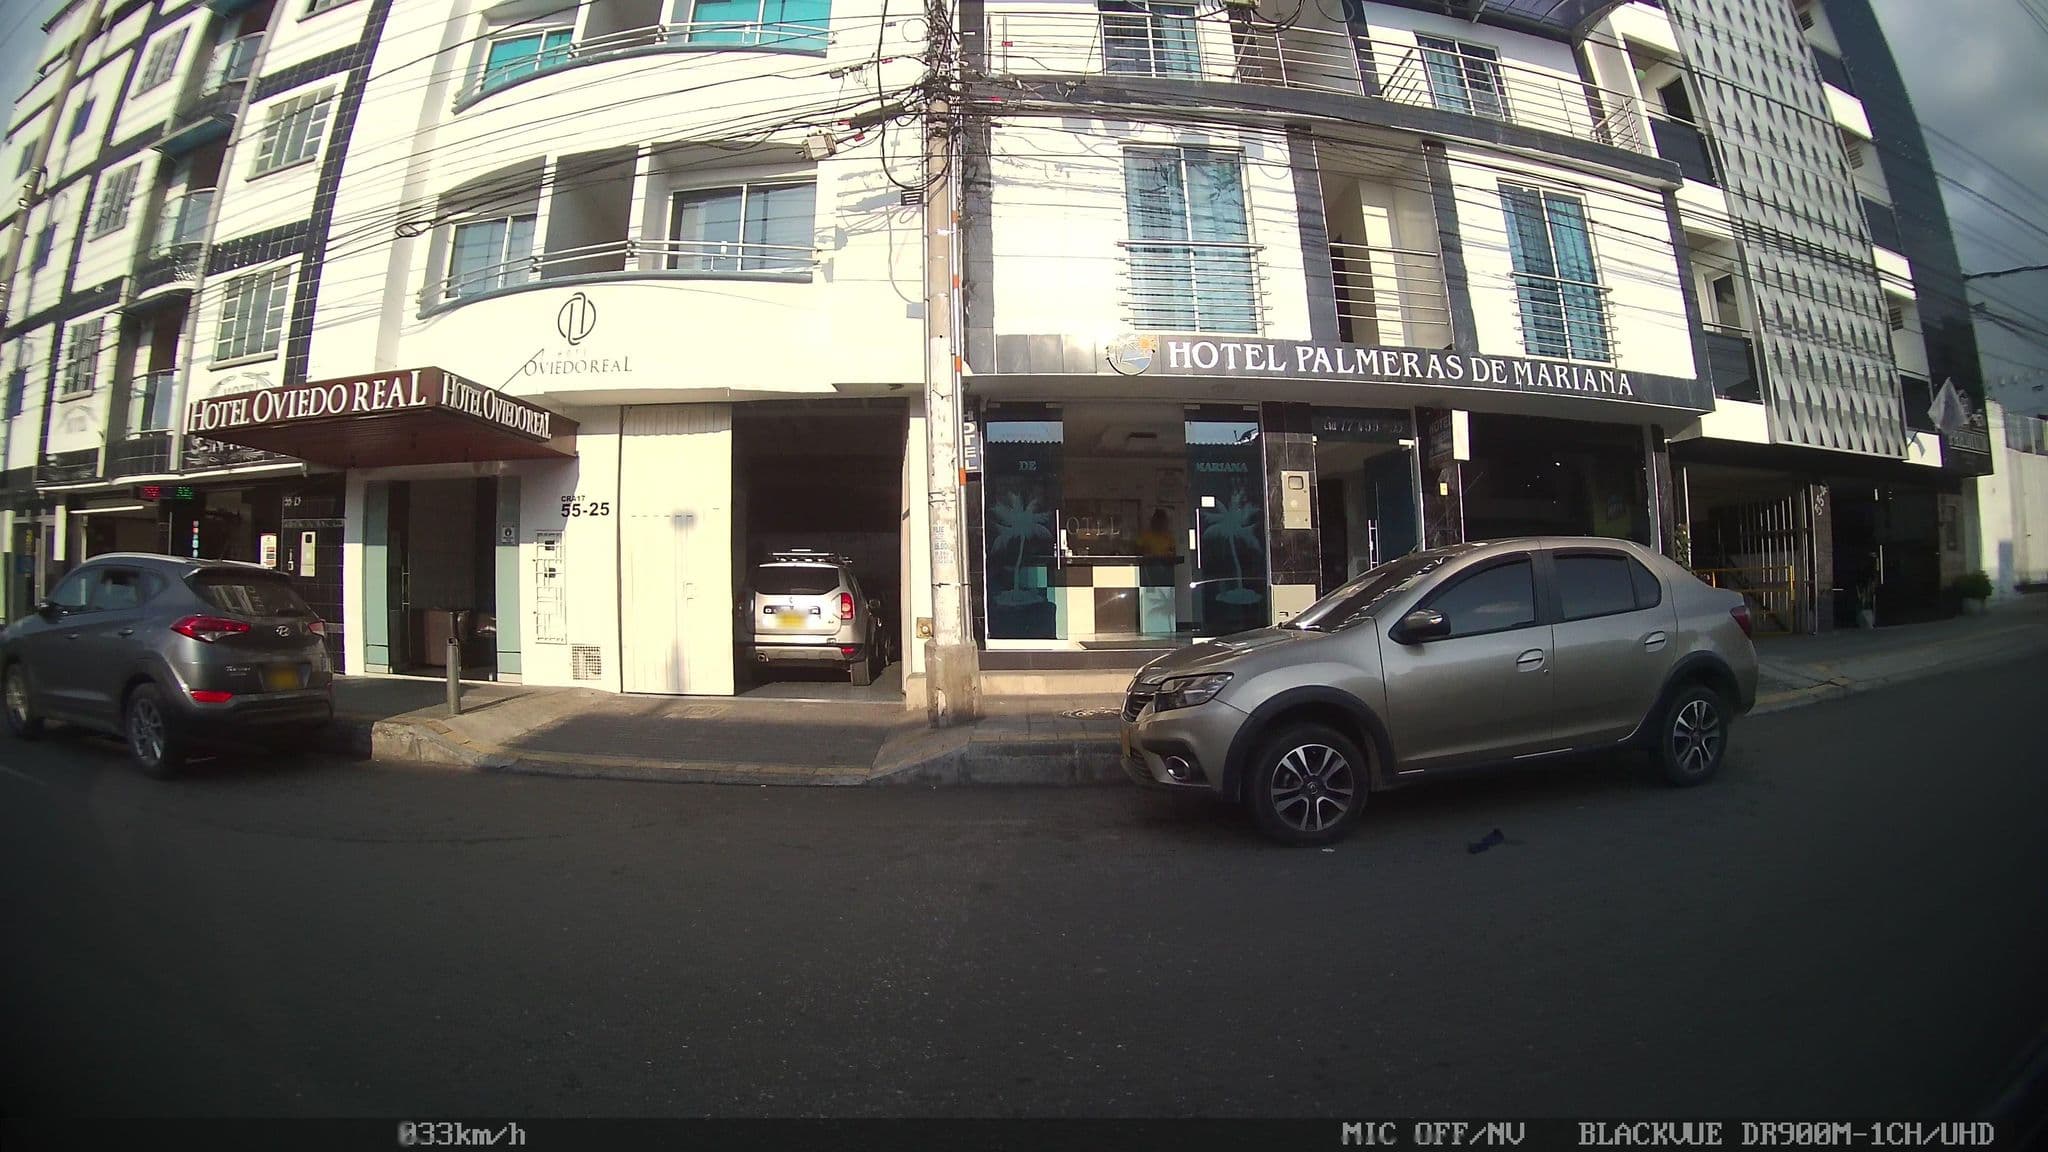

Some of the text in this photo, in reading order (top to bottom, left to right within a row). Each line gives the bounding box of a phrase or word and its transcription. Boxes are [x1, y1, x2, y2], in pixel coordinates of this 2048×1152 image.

[1167, 341, 1634, 396] HOTEL PALMERAS DE MARIANA
[189, 370, 427, 432] HOTEL OVIEDO REAL
[441, 372, 482, 418] HOTEL
[561, 502, 610, 517] 55-25
